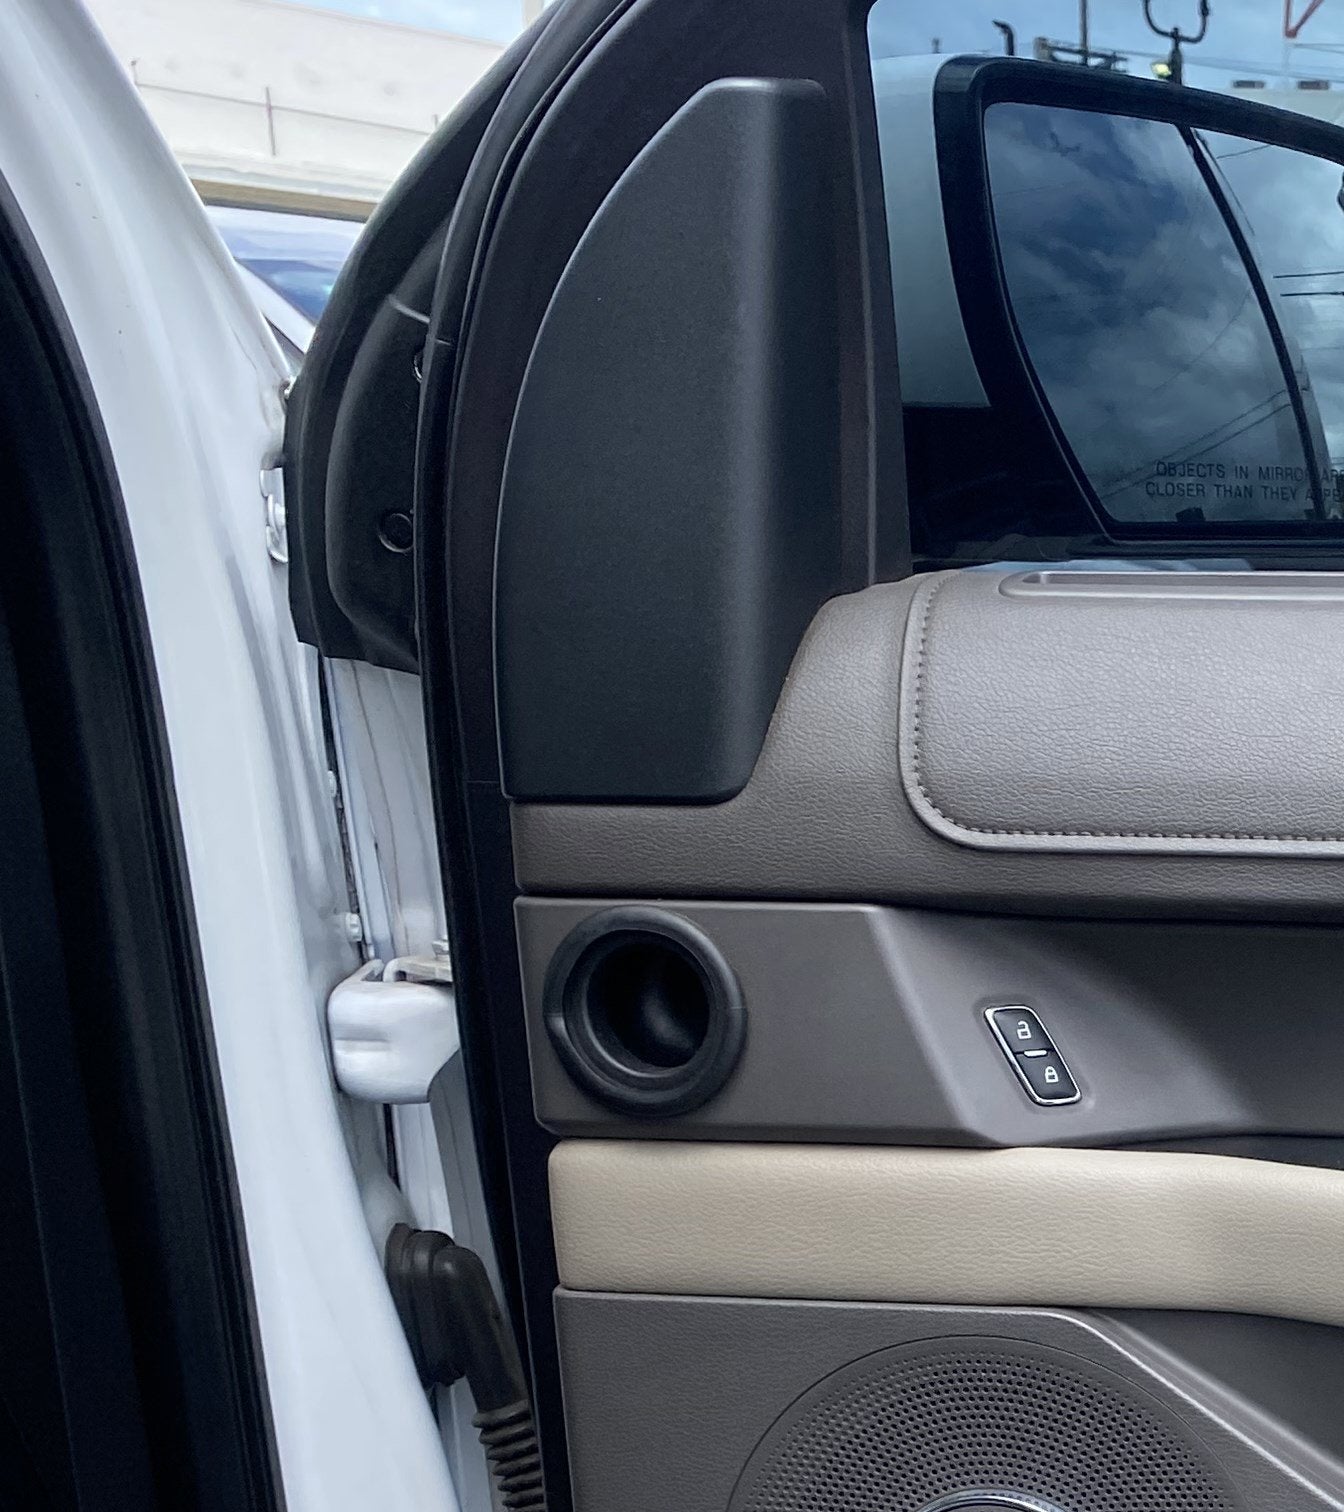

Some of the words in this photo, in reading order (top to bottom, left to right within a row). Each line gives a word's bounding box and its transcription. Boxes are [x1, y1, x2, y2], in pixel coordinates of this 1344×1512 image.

[1156, 461, 1226, 478] OBJECTS
[1235, 464, 1249, 480] IN
[1145, 481, 1205, 498] CLOSER
[1214, 483, 1253, 499] THAN
[1261, 484, 1298, 501] THEY
